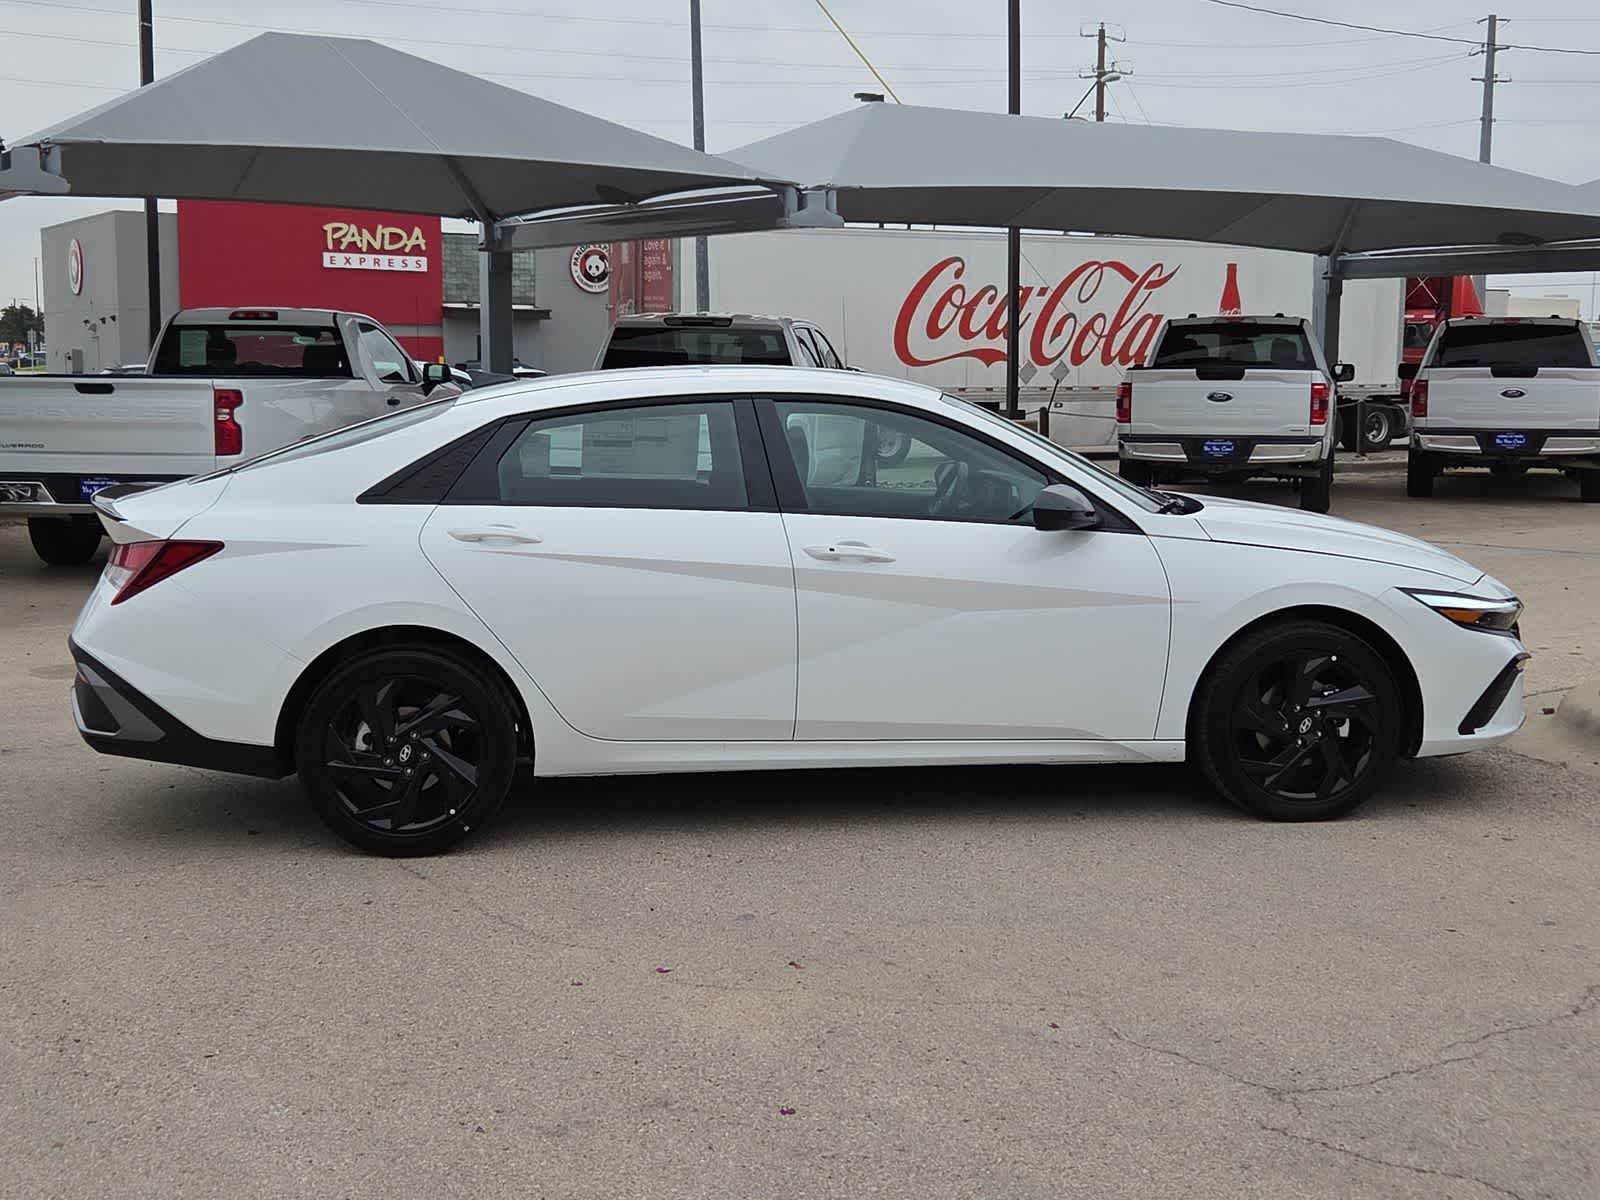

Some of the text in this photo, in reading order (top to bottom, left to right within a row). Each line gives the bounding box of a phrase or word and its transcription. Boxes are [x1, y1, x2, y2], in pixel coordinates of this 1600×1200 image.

[323, 222, 426, 252] PANDA
[328, 255, 422, 269] EXPRESS
[894, 256, 1182, 368] Coca-Cola
